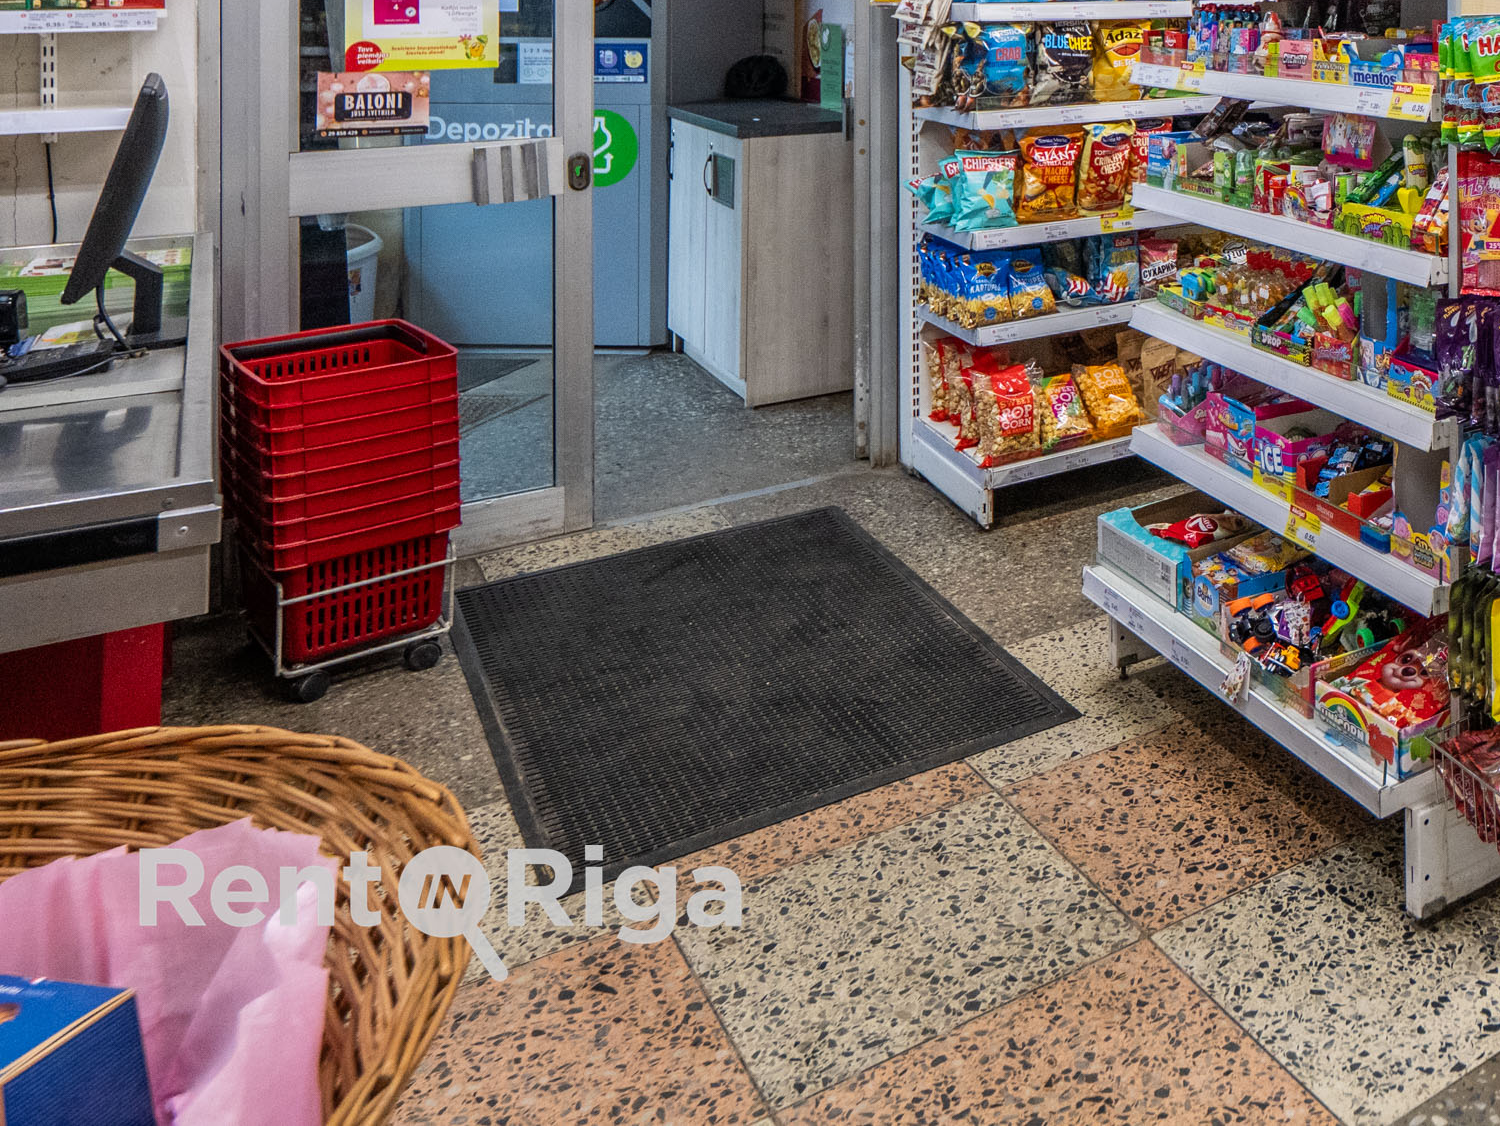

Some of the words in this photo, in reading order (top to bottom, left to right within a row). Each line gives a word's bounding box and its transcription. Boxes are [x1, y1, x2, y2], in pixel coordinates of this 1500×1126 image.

[995, 47, 1021, 60] CRAB
[1353, 71, 1398, 86] mentos
[1395, 84, 1413, 93] Akcija!
[344, 93, 403, 111] BALONI
[1034, 148, 1076, 163] GIANT
[963, 156, 1016, 172] CHIPSTERS
[1101, 161, 1125, 175] CHEESY
[1045, 166, 1069, 176] NACHO
[1043, 174, 1069, 185] CHEESE
[1262, 333, 1282, 348] DROP
[1093, 367, 1120, 380] POP
[1098, 377, 1125, 389] CORN
[1050, 392, 1077, 404] POP
[1002, 404, 1032, 420] POP
[1001, 417, 1032, 430] CORN
[1197, 589, 1213, 606] Barni
